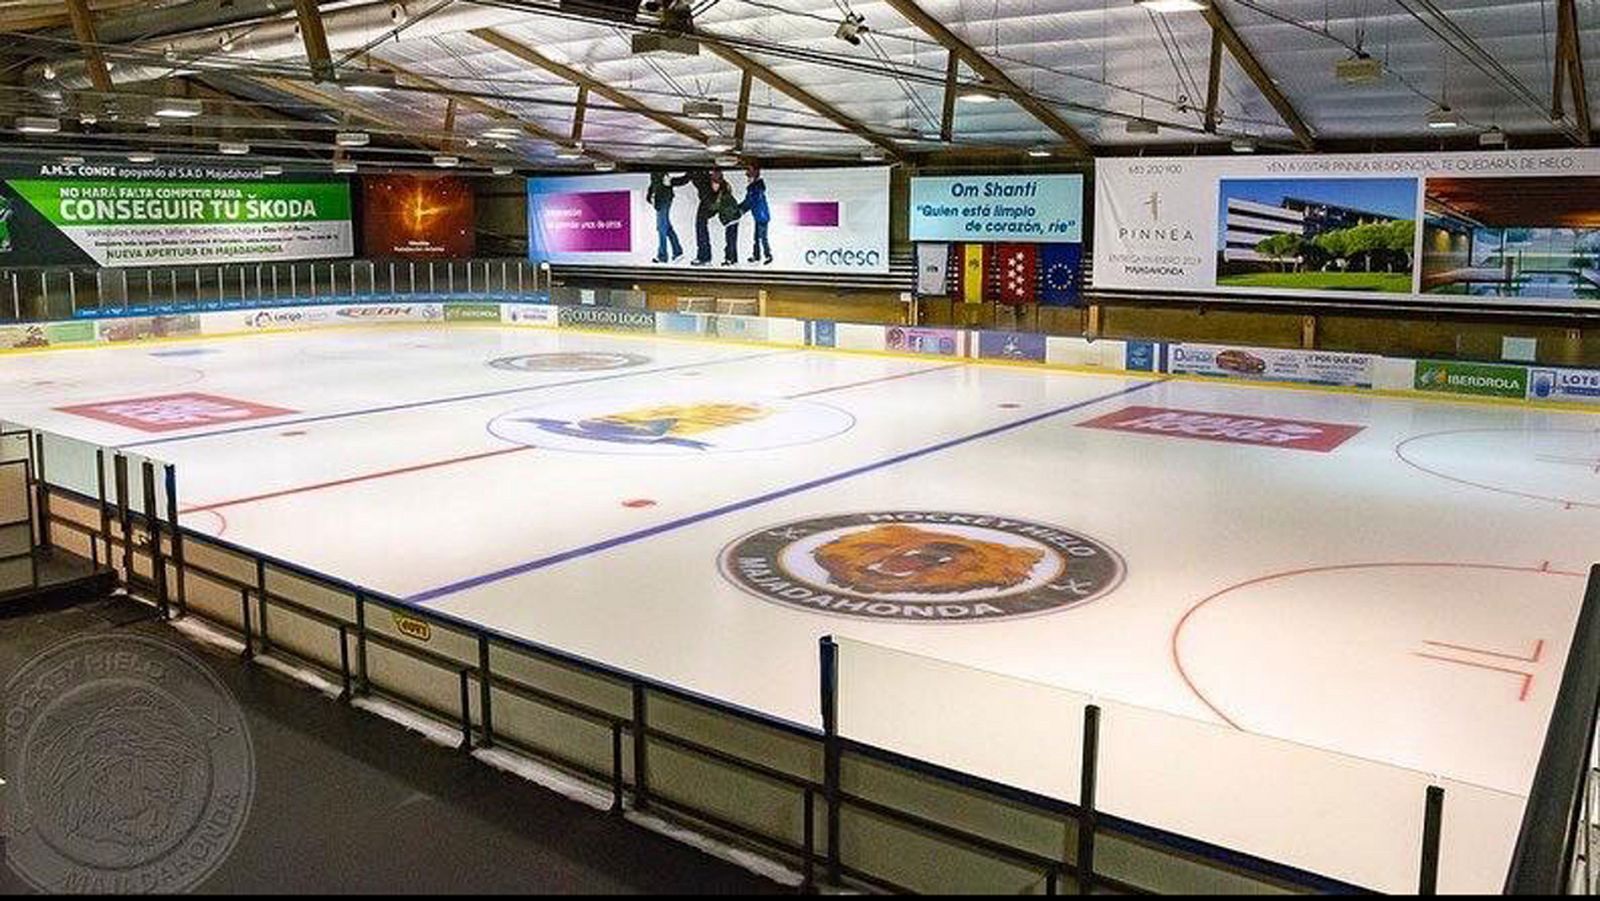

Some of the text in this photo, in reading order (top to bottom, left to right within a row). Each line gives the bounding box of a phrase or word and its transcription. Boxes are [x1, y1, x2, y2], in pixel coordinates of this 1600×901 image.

[40, 165, 76, 176] A.M.S.
[78, 166, 116, 177] CONDE
[118, 167, 166, 179] apoyando
[168, 168, 177, 178] al
[206, 169, 263, 180] Majadahonda
[60, 185, 243, 199] NO HARÁ FALTA COMPETIR PARA
[951, 181, 1037, 198] Om Shanti
[60, 193, 317, 220] CONSEGUIR TU ŠKODA
[962, 204, 990, 218] está
[993, 204, 1036, 220] limpio
[965, 220, 981, 233] de
[985, 220, 1045, 235] corazón,
[106, 249, 143, 260] NUEVA
[145, 247, 199, 258] APERTURA
[201, 246, 213, 256] EN
[805, 249, 880, 267] endesa
[574, 309, 654, 325] COLEGIO LOGOS
[1448, 375, 1520, 390] IBERDROLA
[867, 511, 1097, 558] HOCKEY HIELO
[739, 556, 1003, 617] MAJADAHONDA
